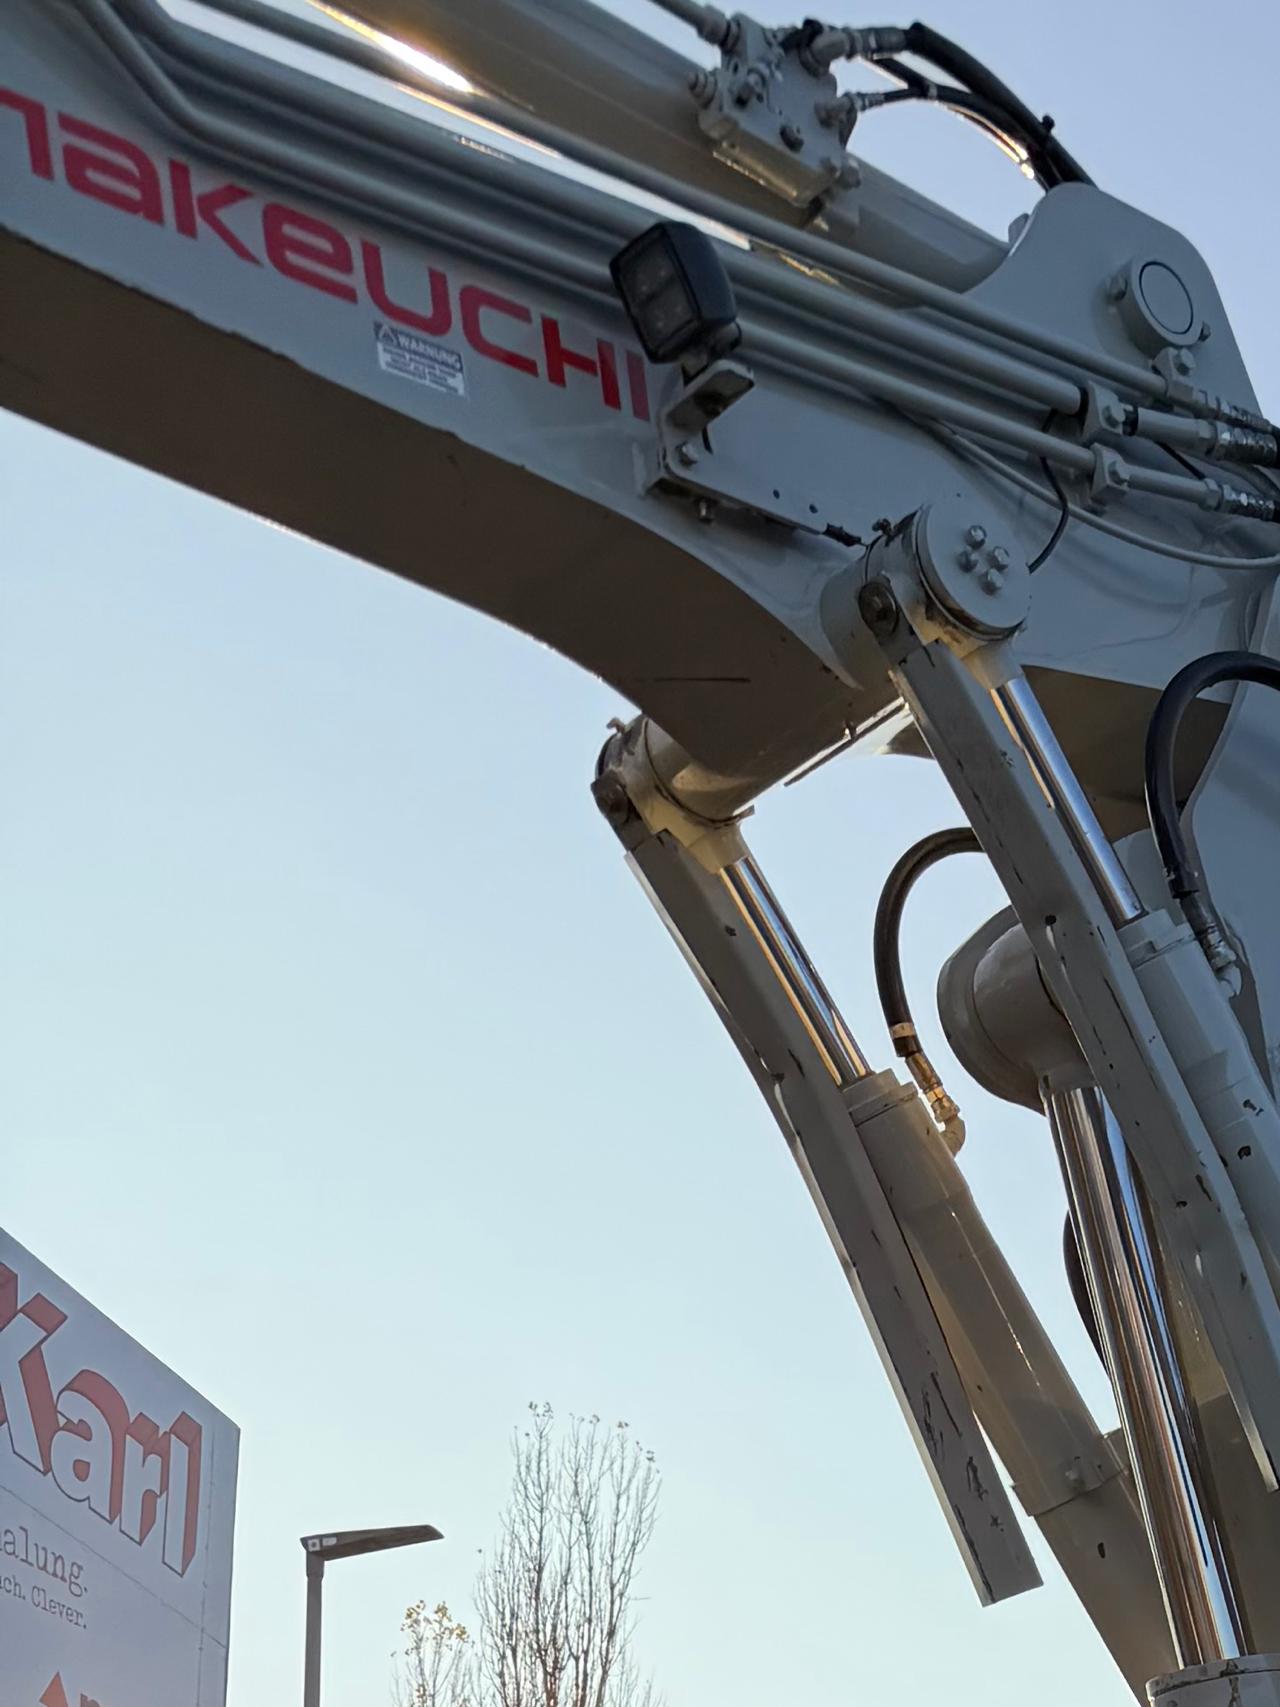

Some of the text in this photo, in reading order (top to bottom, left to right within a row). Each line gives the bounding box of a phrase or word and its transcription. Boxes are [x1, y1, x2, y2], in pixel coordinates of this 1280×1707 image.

[0, 1526, 88, 1597] alung.
[0, 1575, 87, 1630] ch. Clever.
